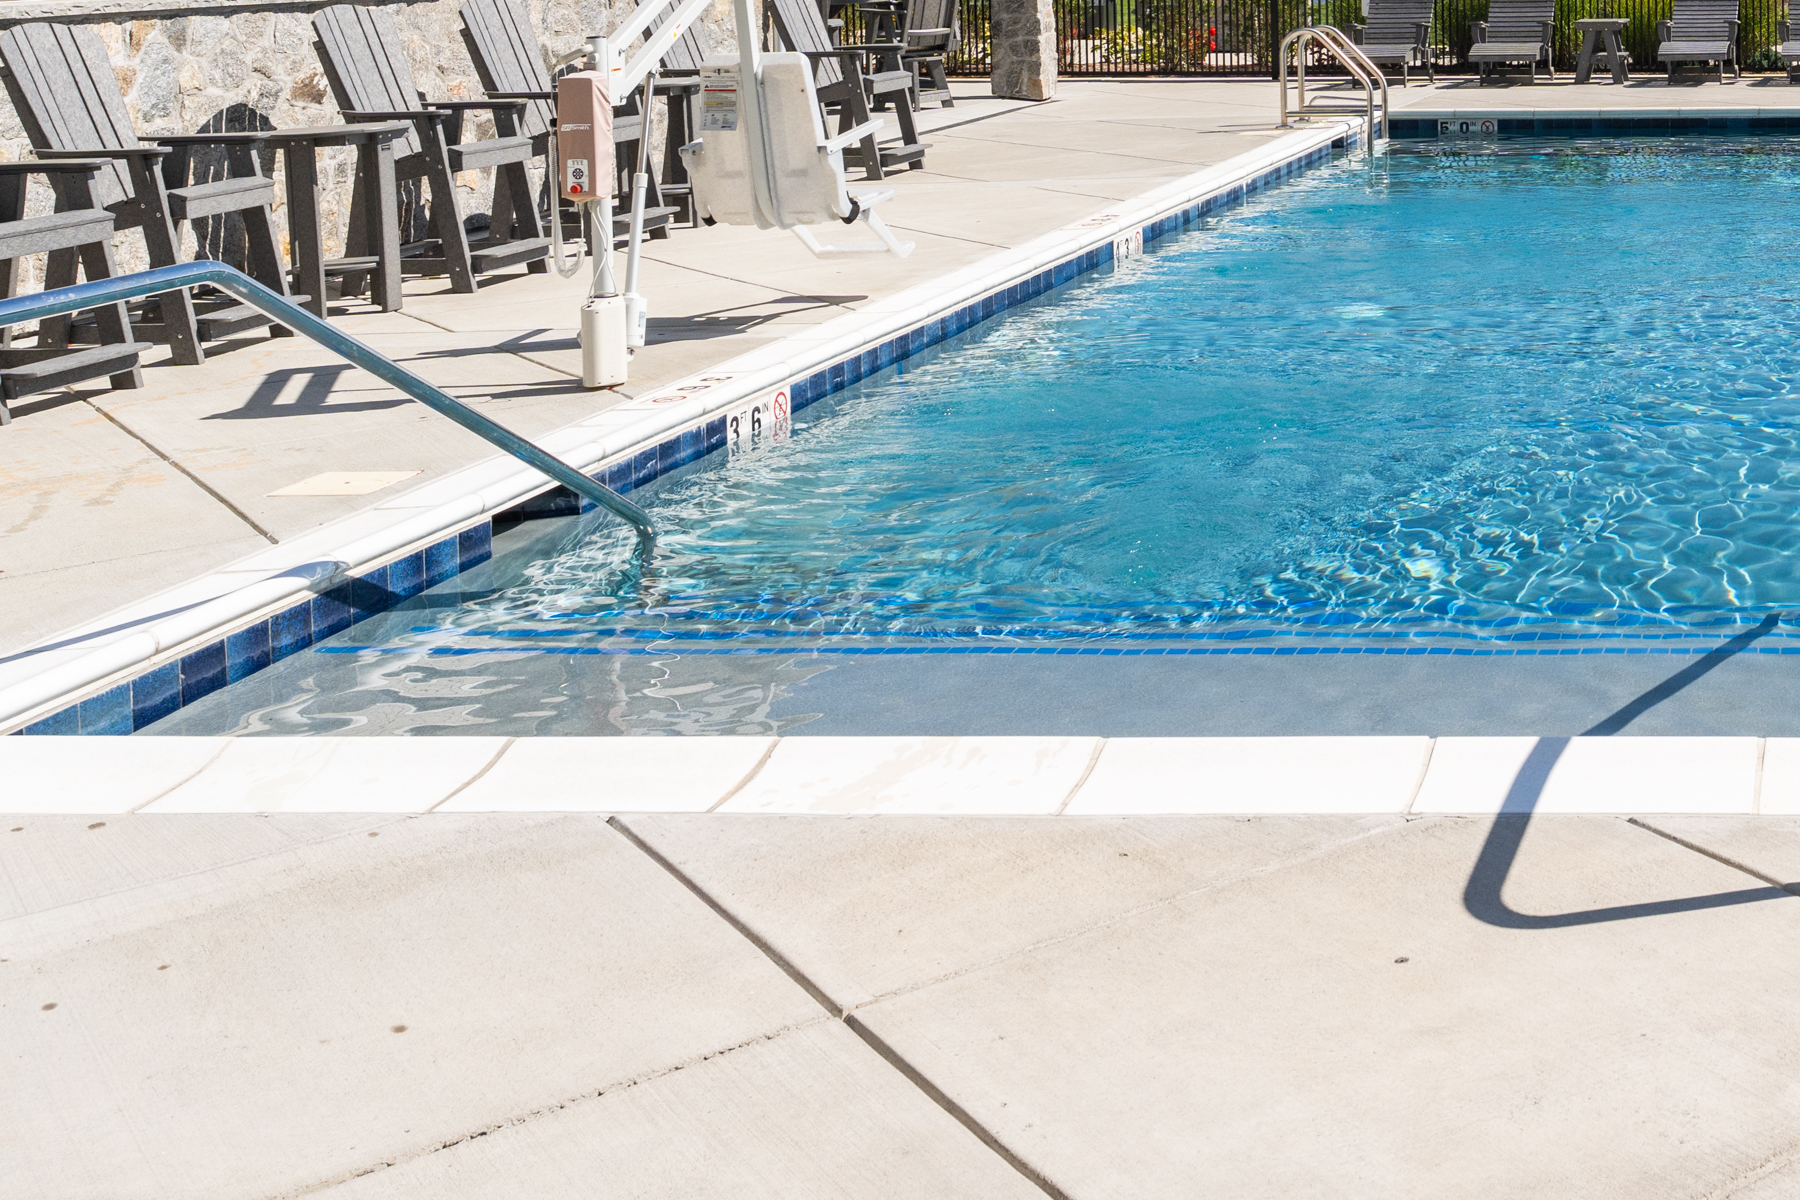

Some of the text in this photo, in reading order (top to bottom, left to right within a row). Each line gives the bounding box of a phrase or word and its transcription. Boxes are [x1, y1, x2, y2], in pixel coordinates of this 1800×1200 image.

[1440, 121, 1449, 134] 5
[1459, 121, 1469, 134] 0
[729, 401, 769, 440] 3 FT 6 IN
